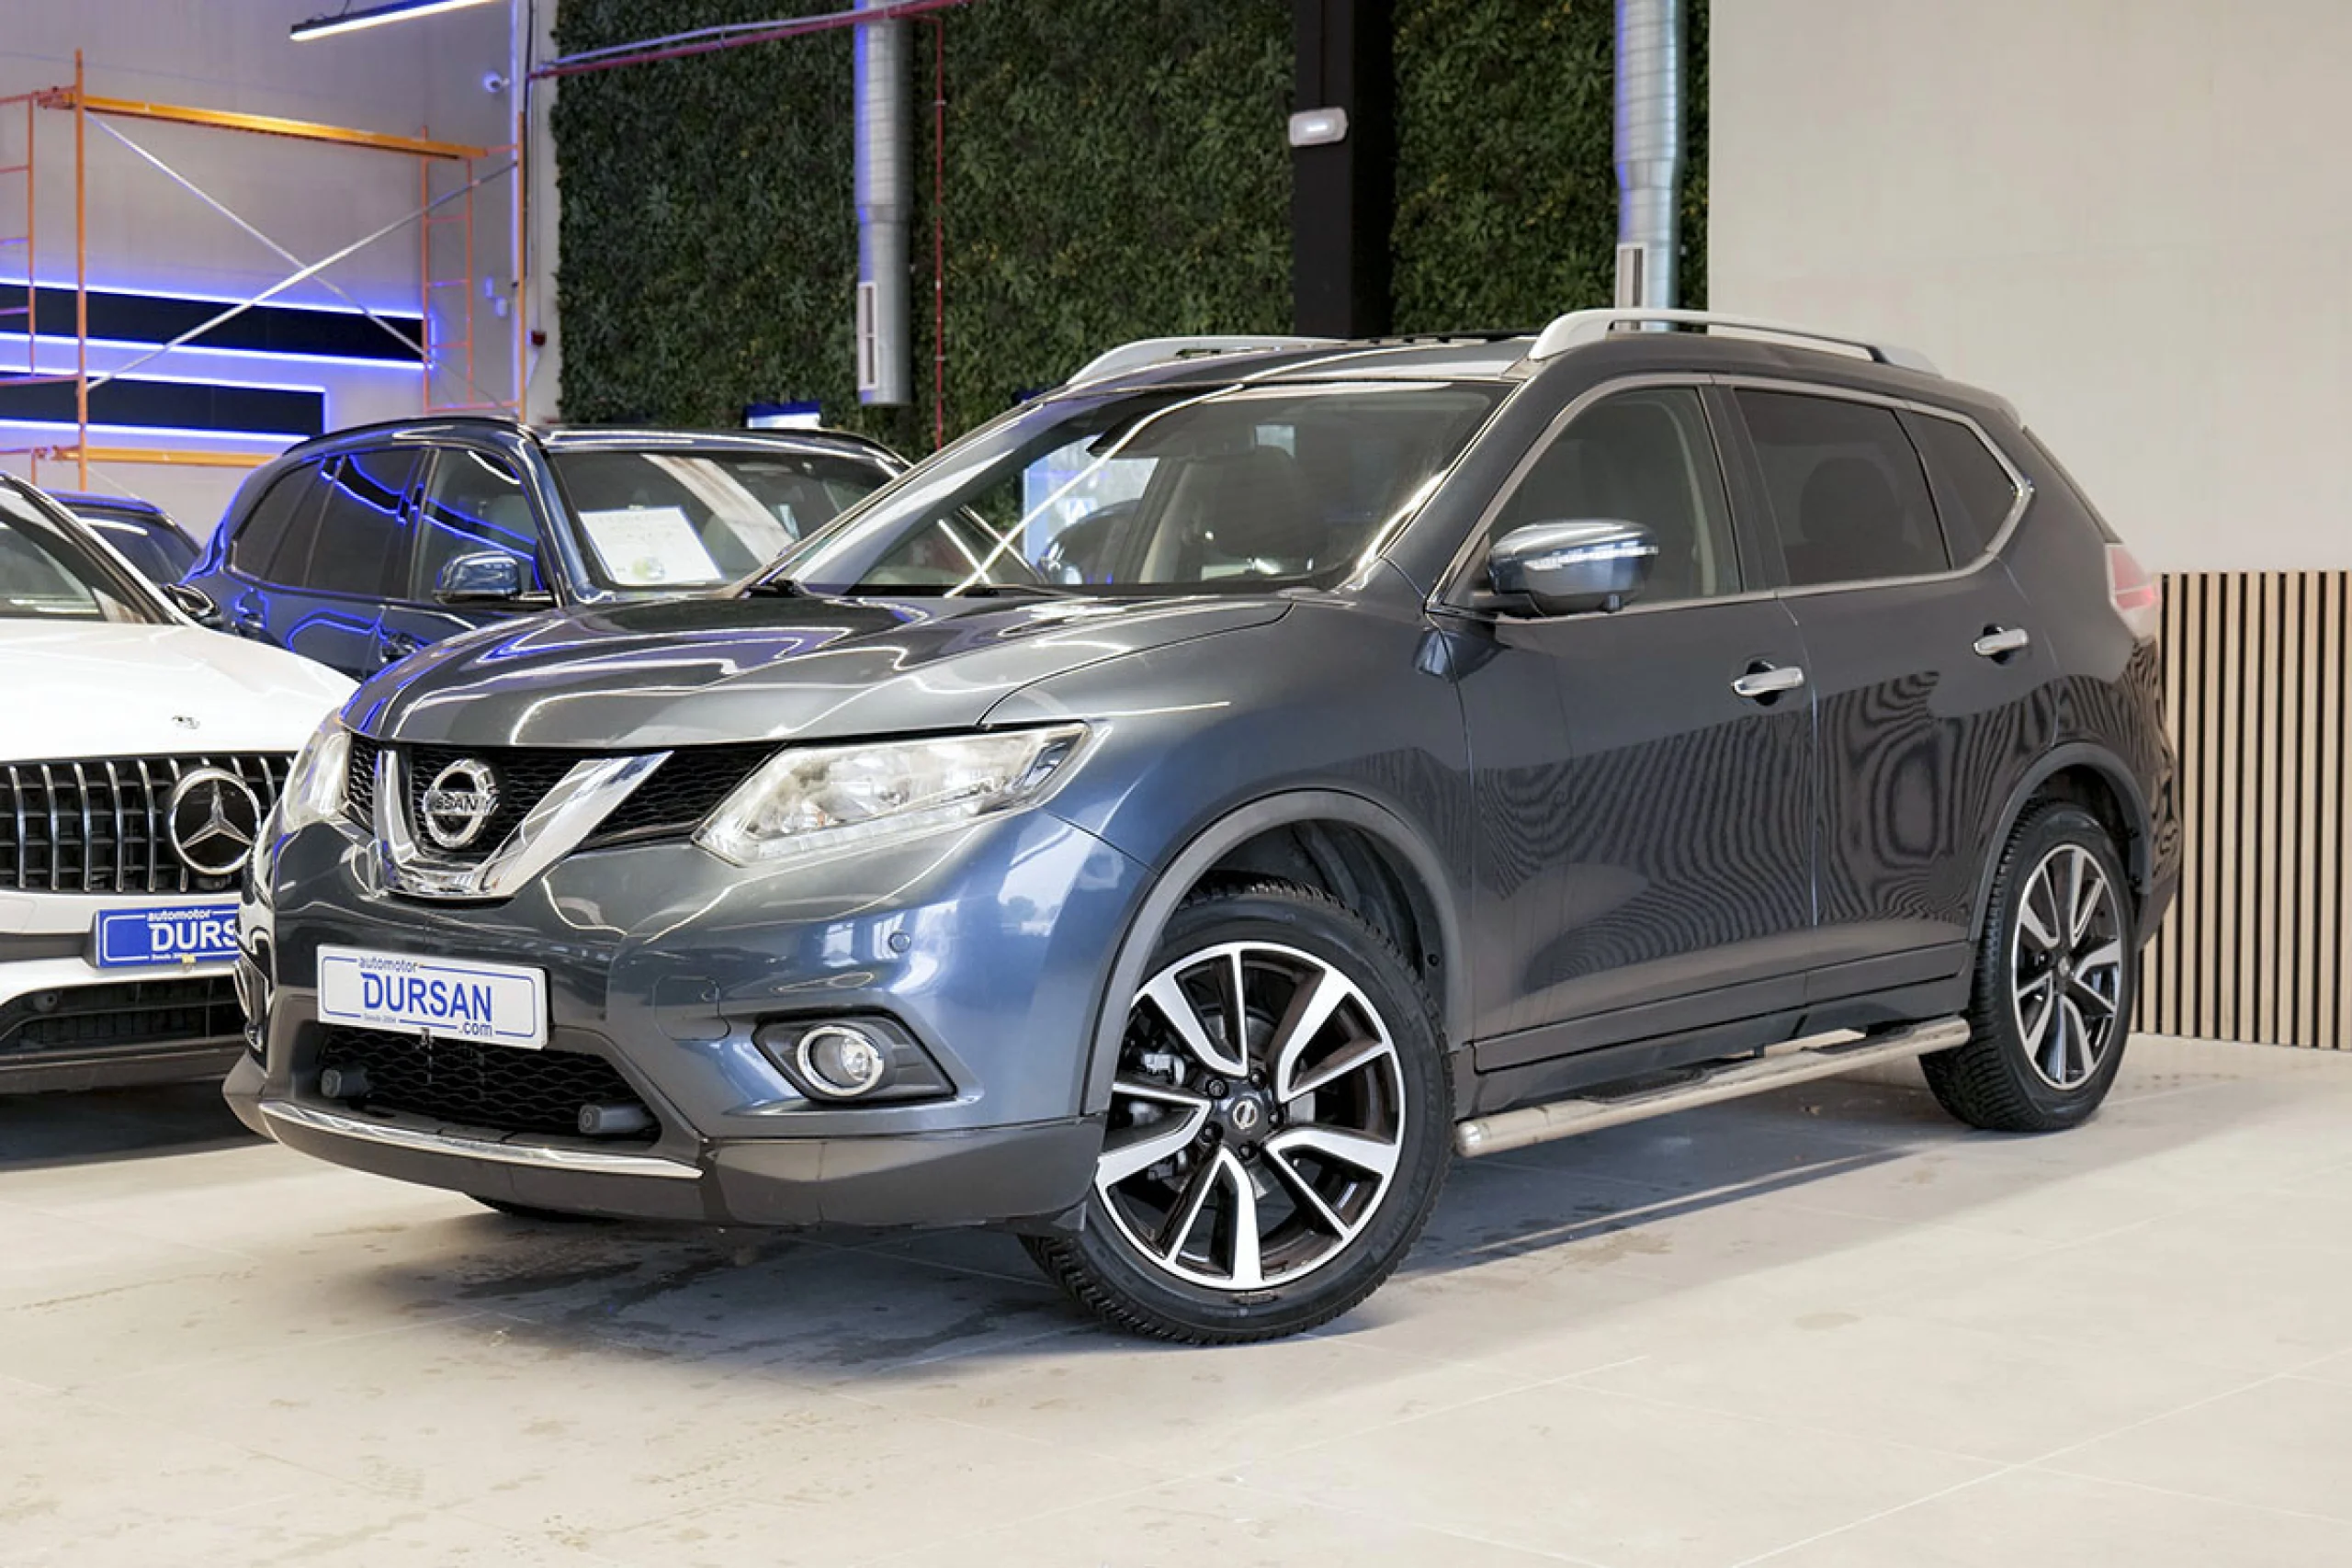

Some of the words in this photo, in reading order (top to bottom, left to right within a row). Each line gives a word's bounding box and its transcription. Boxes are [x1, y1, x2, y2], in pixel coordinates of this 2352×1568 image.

[148, 908, 210, 921] automotor
[359, 956, 418, 973] automotor
[360, 972, 492, 1022] DURSAN
[458, 1021, 492, 1036] .com
